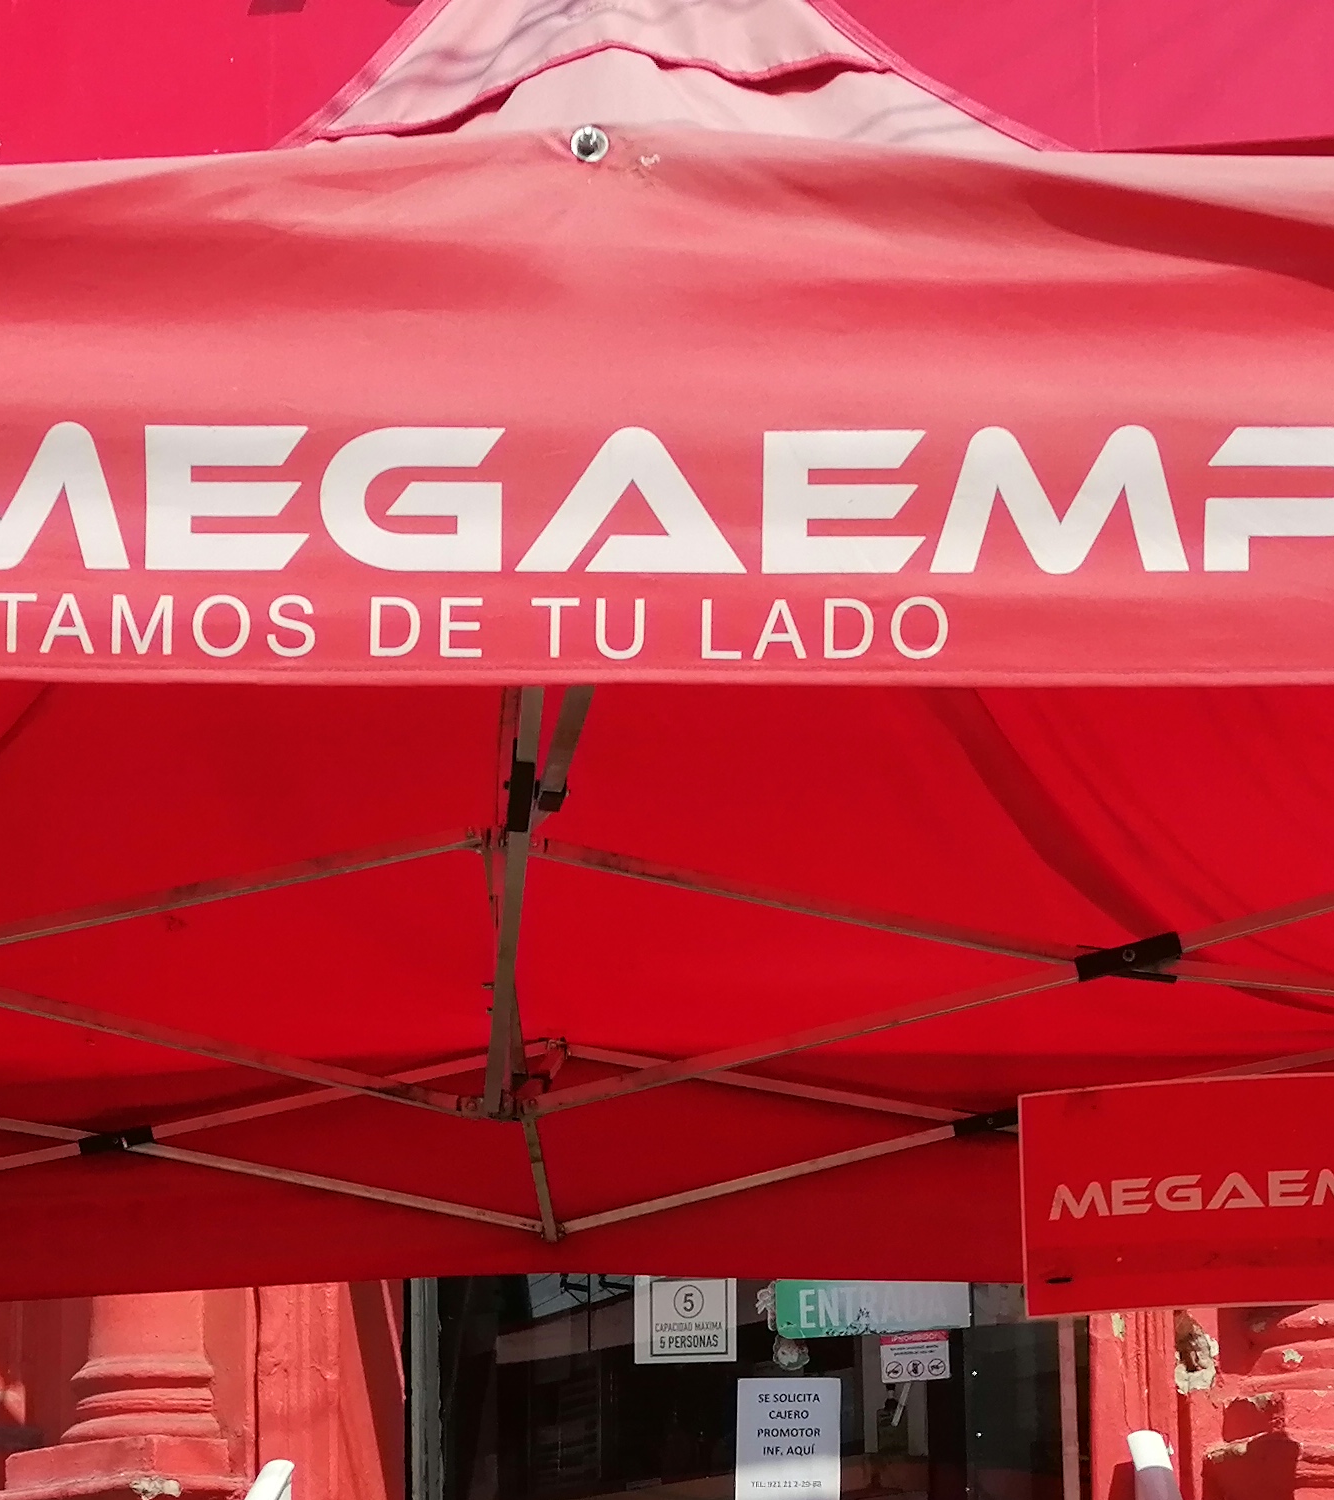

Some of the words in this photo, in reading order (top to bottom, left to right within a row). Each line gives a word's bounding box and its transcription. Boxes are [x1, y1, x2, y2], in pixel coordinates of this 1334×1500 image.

[369, 595, 484, 659] DE
[531, 596, 647, 660] TU
[701, 596, 951, 661] LADO
[682, 1293, 694, 1312] 5
[655, 1322, 693, 1333] CAPACIDAD
[659, 1336, 666, 1349] 5
[667, 1335, 719, 1349] PERSONAS
[758, 1393, 770, 1403] SE
[773, 1393, 821, 1403] SOLICITA
[769, 1410, 809, 1420] CAJERO
[757, 1428, 821, 1438] PROMOTOR
[763, 1446, 783, 1456] INF.
[786, 1444, 816, 1457] AQUÍ
